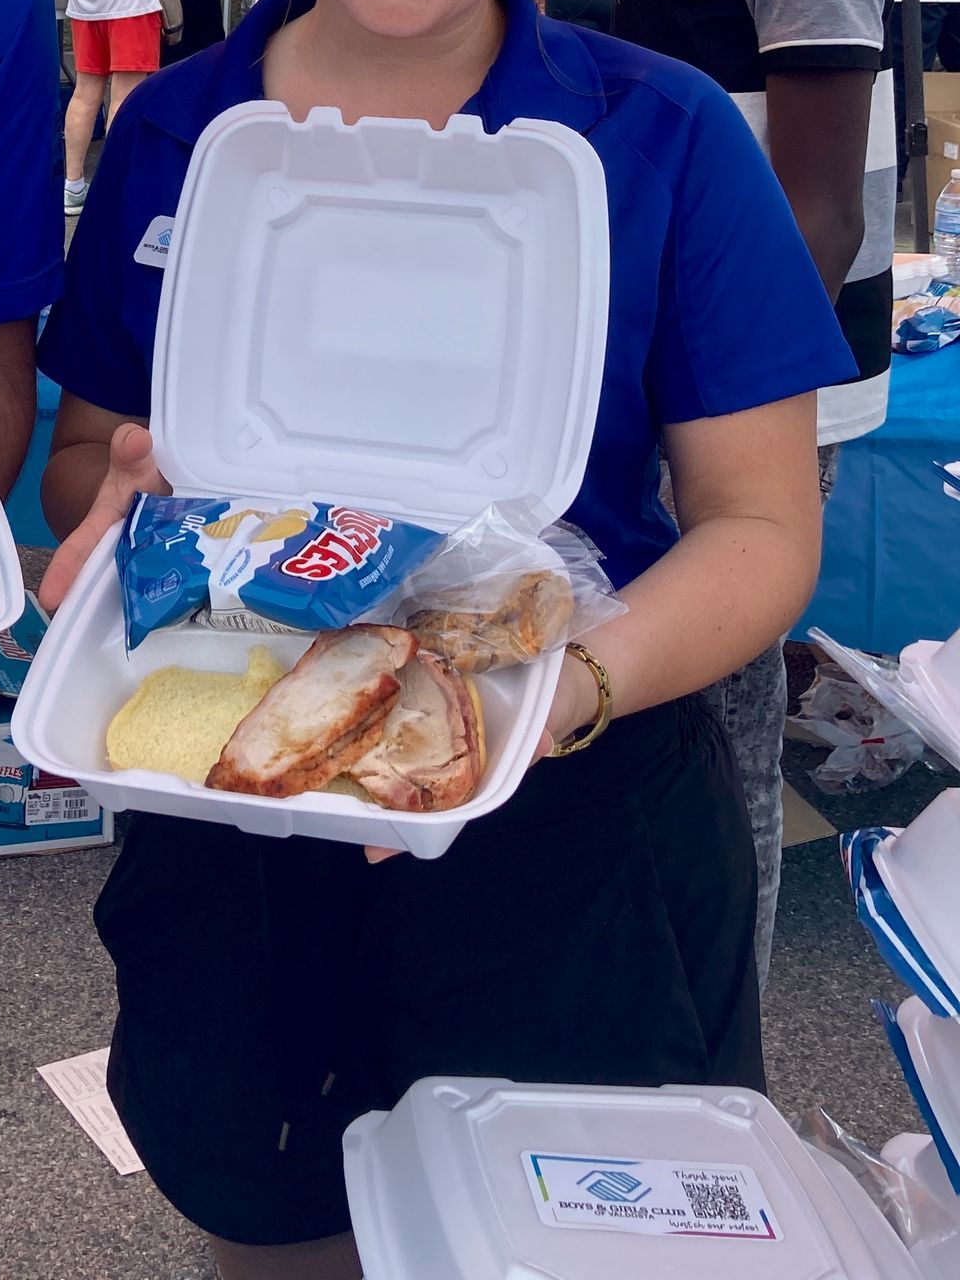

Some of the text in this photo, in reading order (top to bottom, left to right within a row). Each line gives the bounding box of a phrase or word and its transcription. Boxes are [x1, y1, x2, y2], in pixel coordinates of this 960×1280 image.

[559, 1201, 593, 1210] BOYS
[609, 1205, 648, 1215] GIRLS
[651, 1207, 686, 1216] CLUB
[609, 1211, 655, 1220] VALDOSTA
